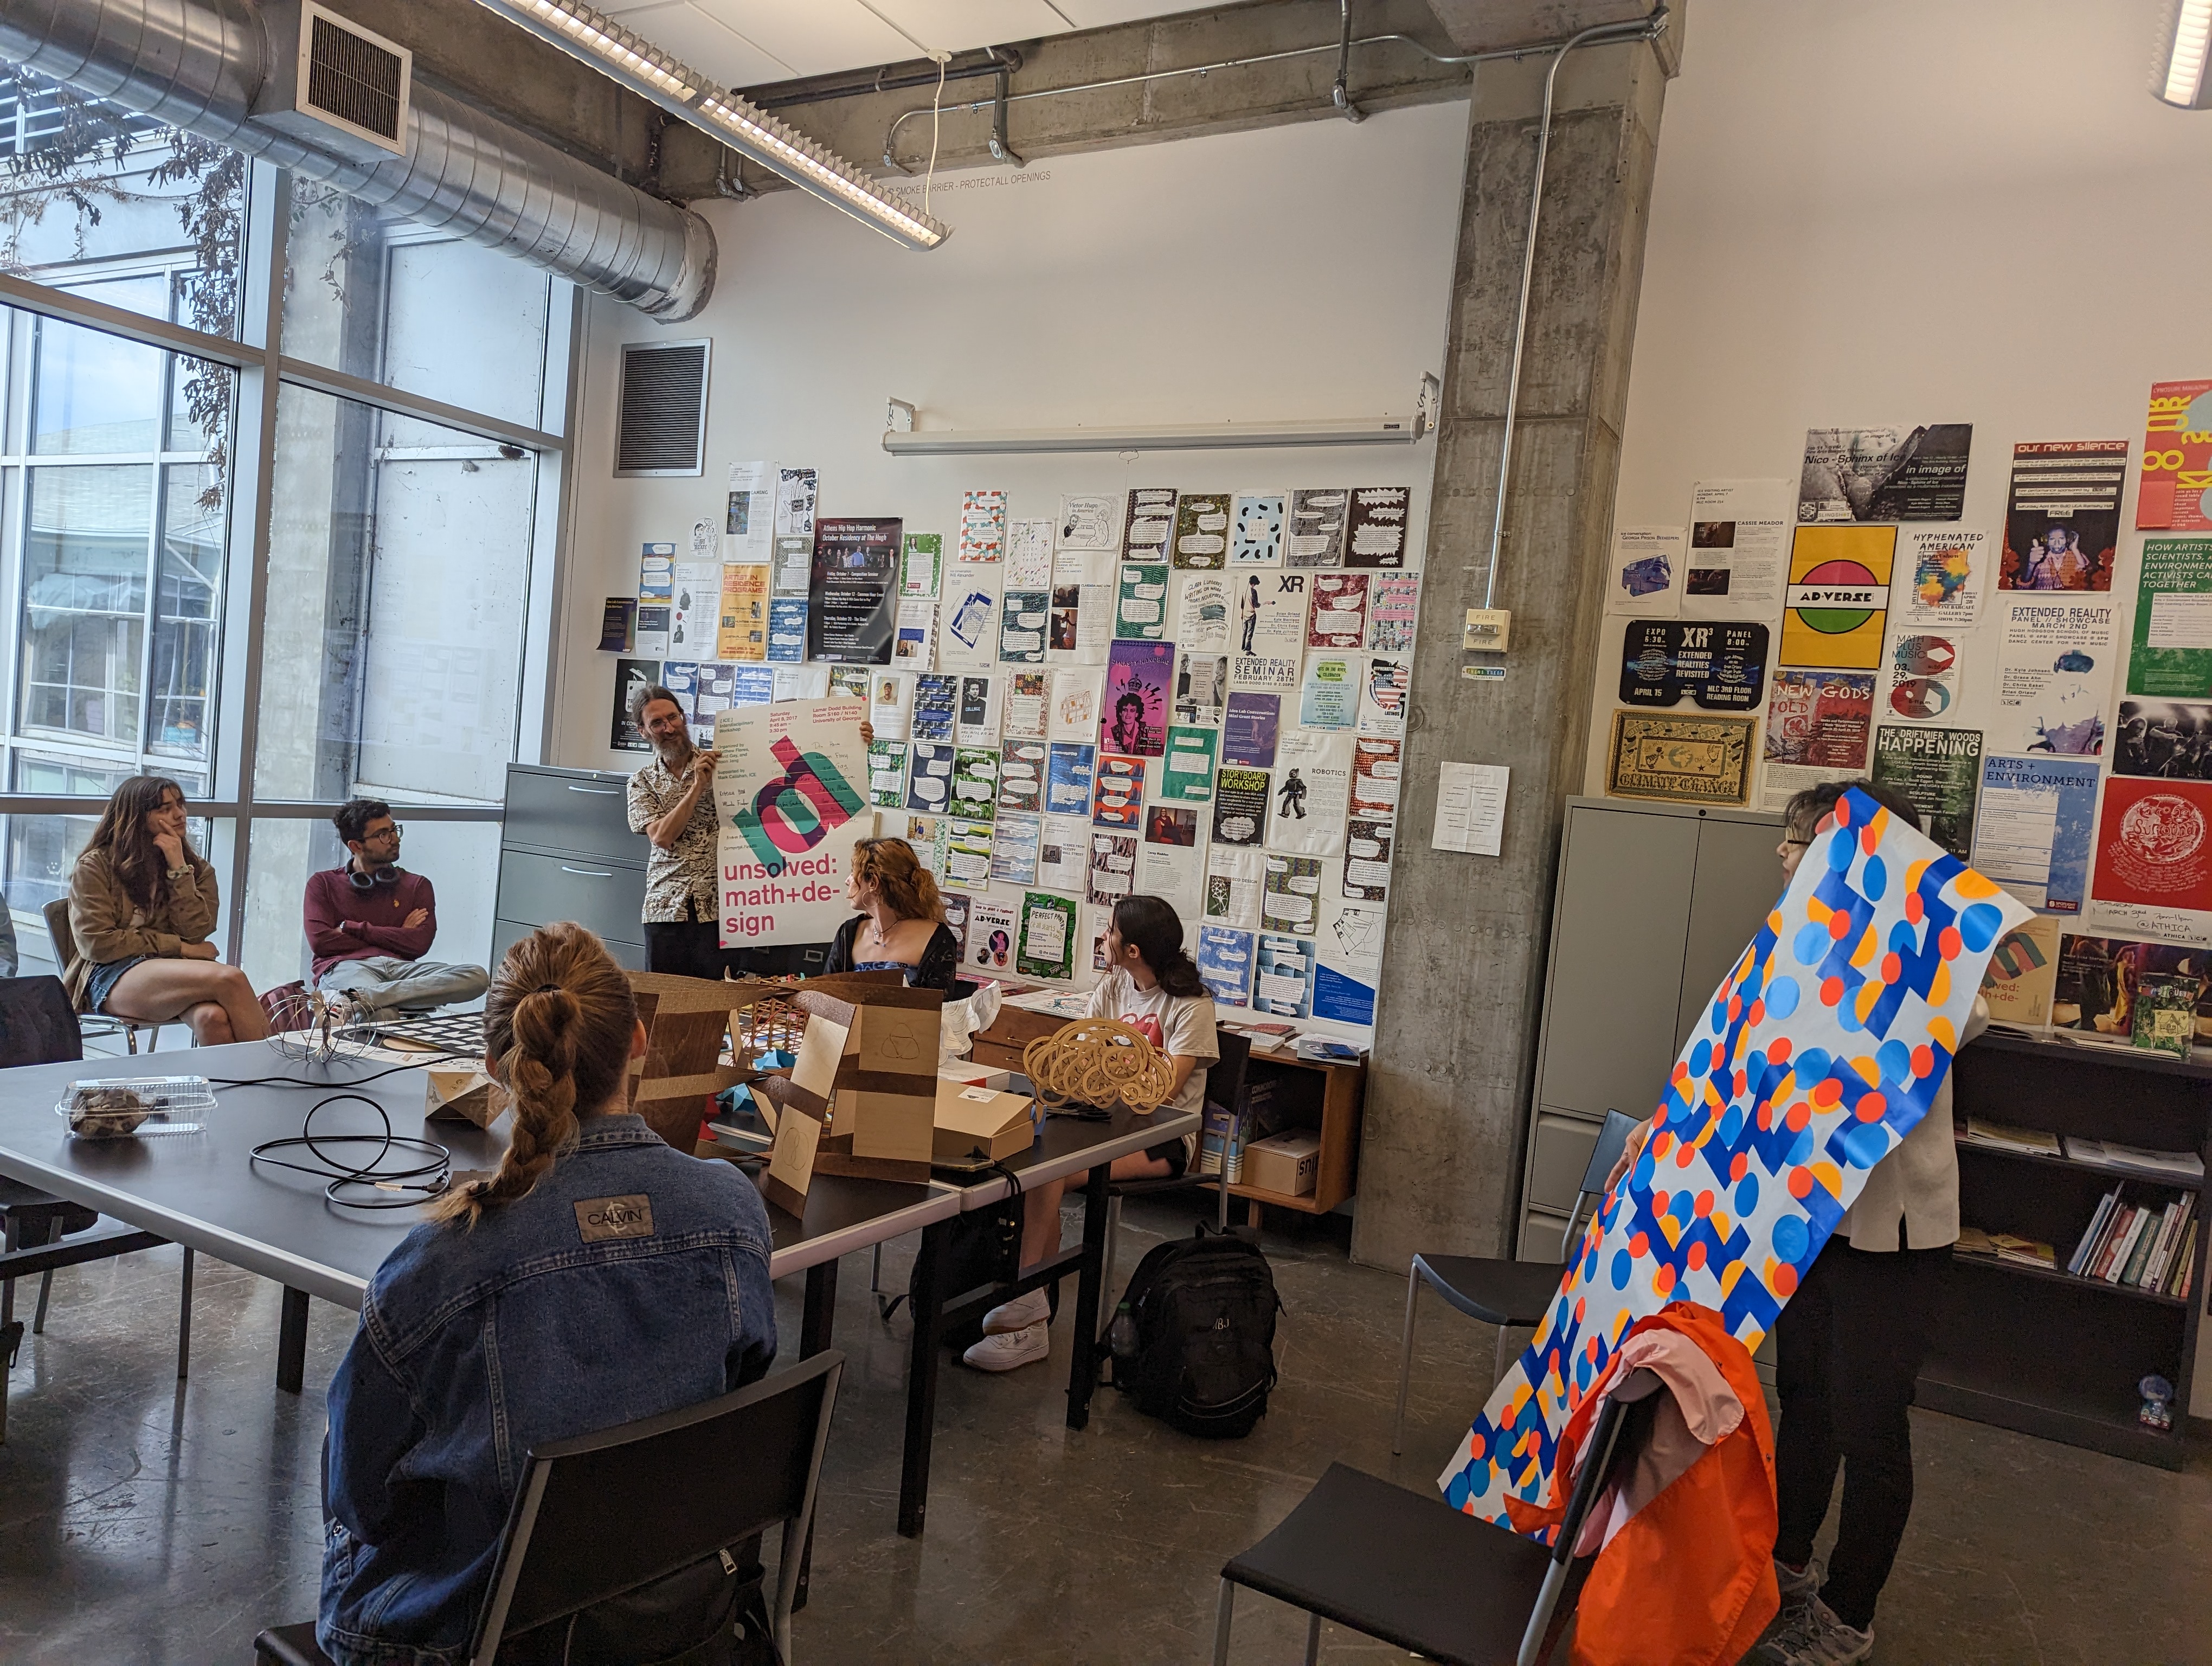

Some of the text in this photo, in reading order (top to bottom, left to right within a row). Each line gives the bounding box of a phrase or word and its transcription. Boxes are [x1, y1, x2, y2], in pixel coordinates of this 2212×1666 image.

[896, 185, 921, 196] SMOKE
[1011, 171, 1051, 184] OPENINGS
[2043, 444, 2073, 452] new
[2076, 442, 2125, 451] silence
[1804, 456, 1829, 464] Nico
[1838, 453, 1873, 464] Sphinx
[1876, 453, 1887, 462] of
[1906, 464, 1966, 475] in image of
[1919, 543, 1975, 551] AMERICAN
[1278, 575, 1304, 593] XR
[2012, 607, 2112, 618] EXTENDED REALITY
[1726, 630, 1752, 638] PANEL
[1678, 651, 1712, 659] EXTENDED
[1111, 659, 1138, 667] DYNASTY
[1235, 657, 1296, 667] EXTENDED REALITY
[1677, 660, 1709, 668] REALITIES
[1235, 665, 1295, 676] SEMINAR
[1676, 670, 1709, 678] REVISITED
[1893, 671, 1907, 680] 29,
[1634, 688, 1653, 696] APRIL
[1734, 686, 1752, 694] FLOOR
[1777, 684, 1870, 700] NEW GODS
[1880, 728, 1981, 742] THE DRIFTMIER WOODS
[1878, 736, 1979, 757] HAPPENING
[1988, 759, 2023, 769] ARTS
[1221, 769, 1266, 781] STORYBOARD
[1986, 771, 2096, 787] ENVIRONMENT
[1221, 778, 1265, 791] WORKSHOP
[1619, 773, 1738, 794] CLIMATE CHANGE
[2133, 818, 2196, 836] Surround
[724, 853, 838, 881] unsolved:
[725, 881, 840, 907] math+de-
[1031, 911, 1053, 920] PERFECT
[725, 911, 774, 937] sign
[1042, 924, 1055, 932] starts
[588, 1209, 642, 1226] CALVIN
